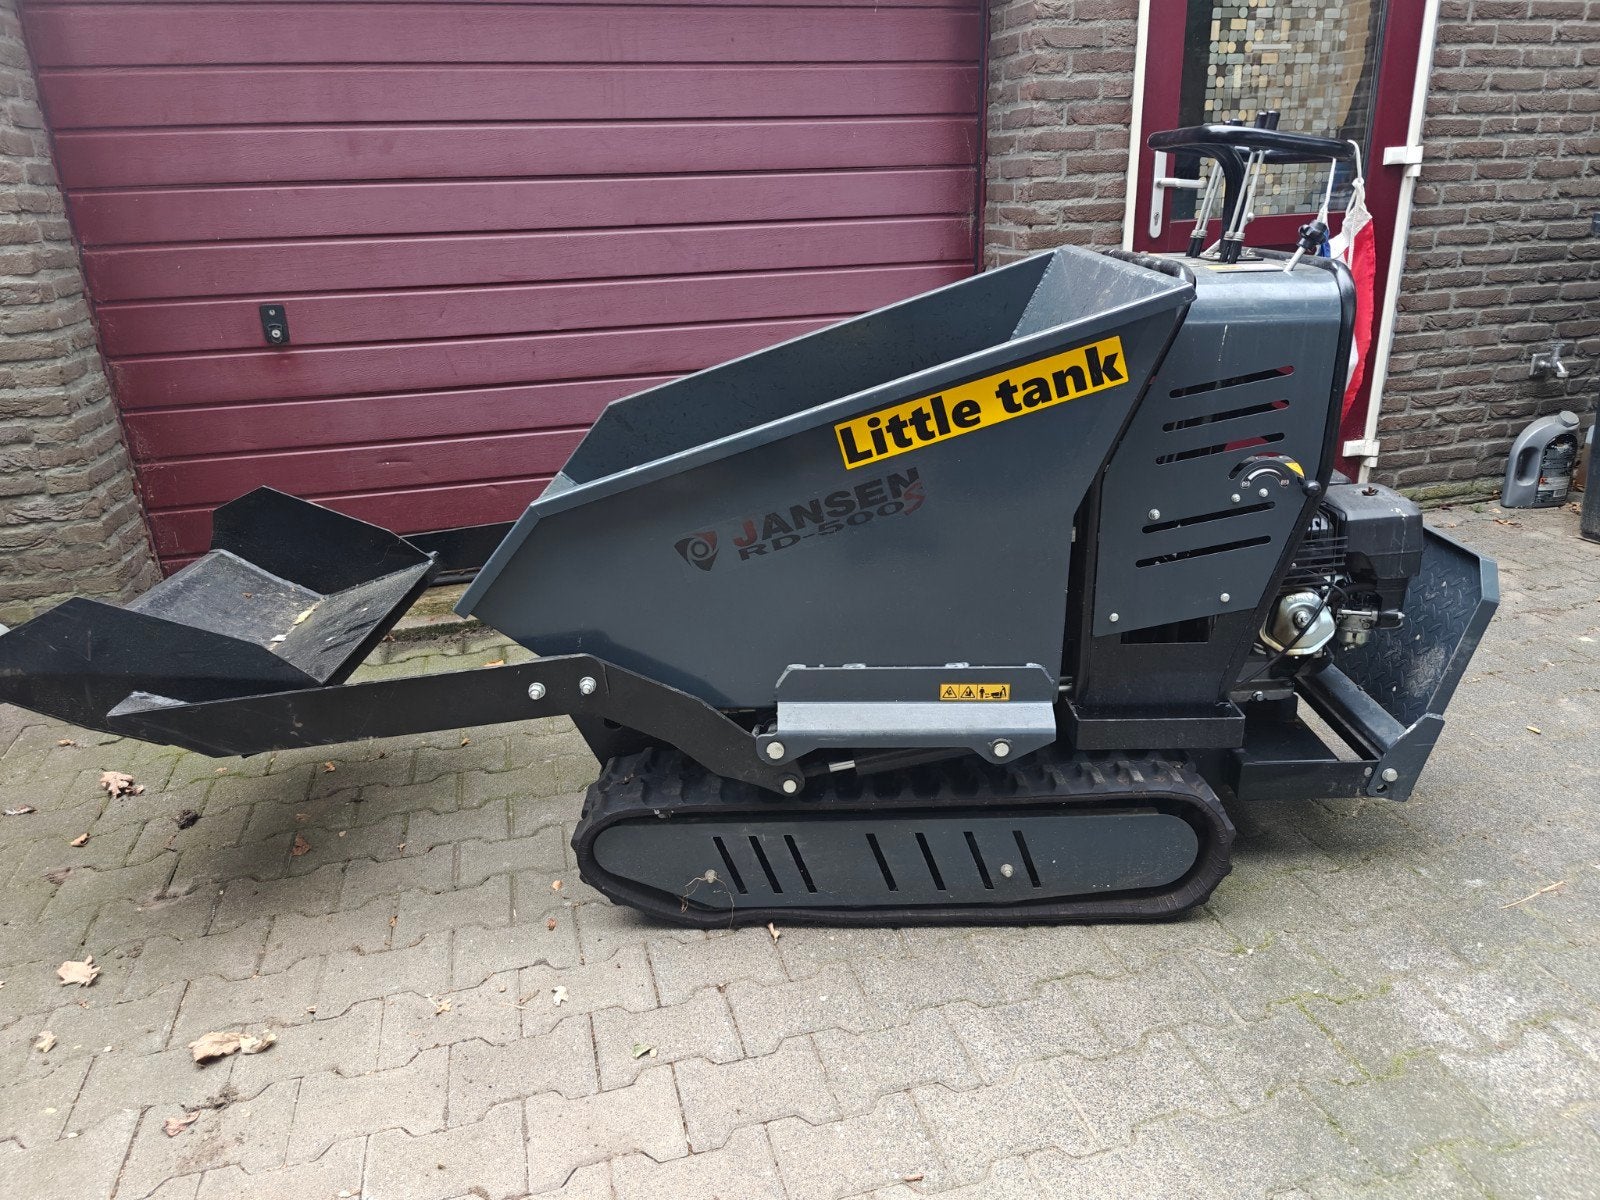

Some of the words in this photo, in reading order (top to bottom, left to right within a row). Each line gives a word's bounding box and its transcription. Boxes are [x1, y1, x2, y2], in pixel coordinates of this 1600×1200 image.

[839, 395, 981, 465] Little
[995, 346, 1124, 414] tank
[732, 467, 922, 548] JANSEN
